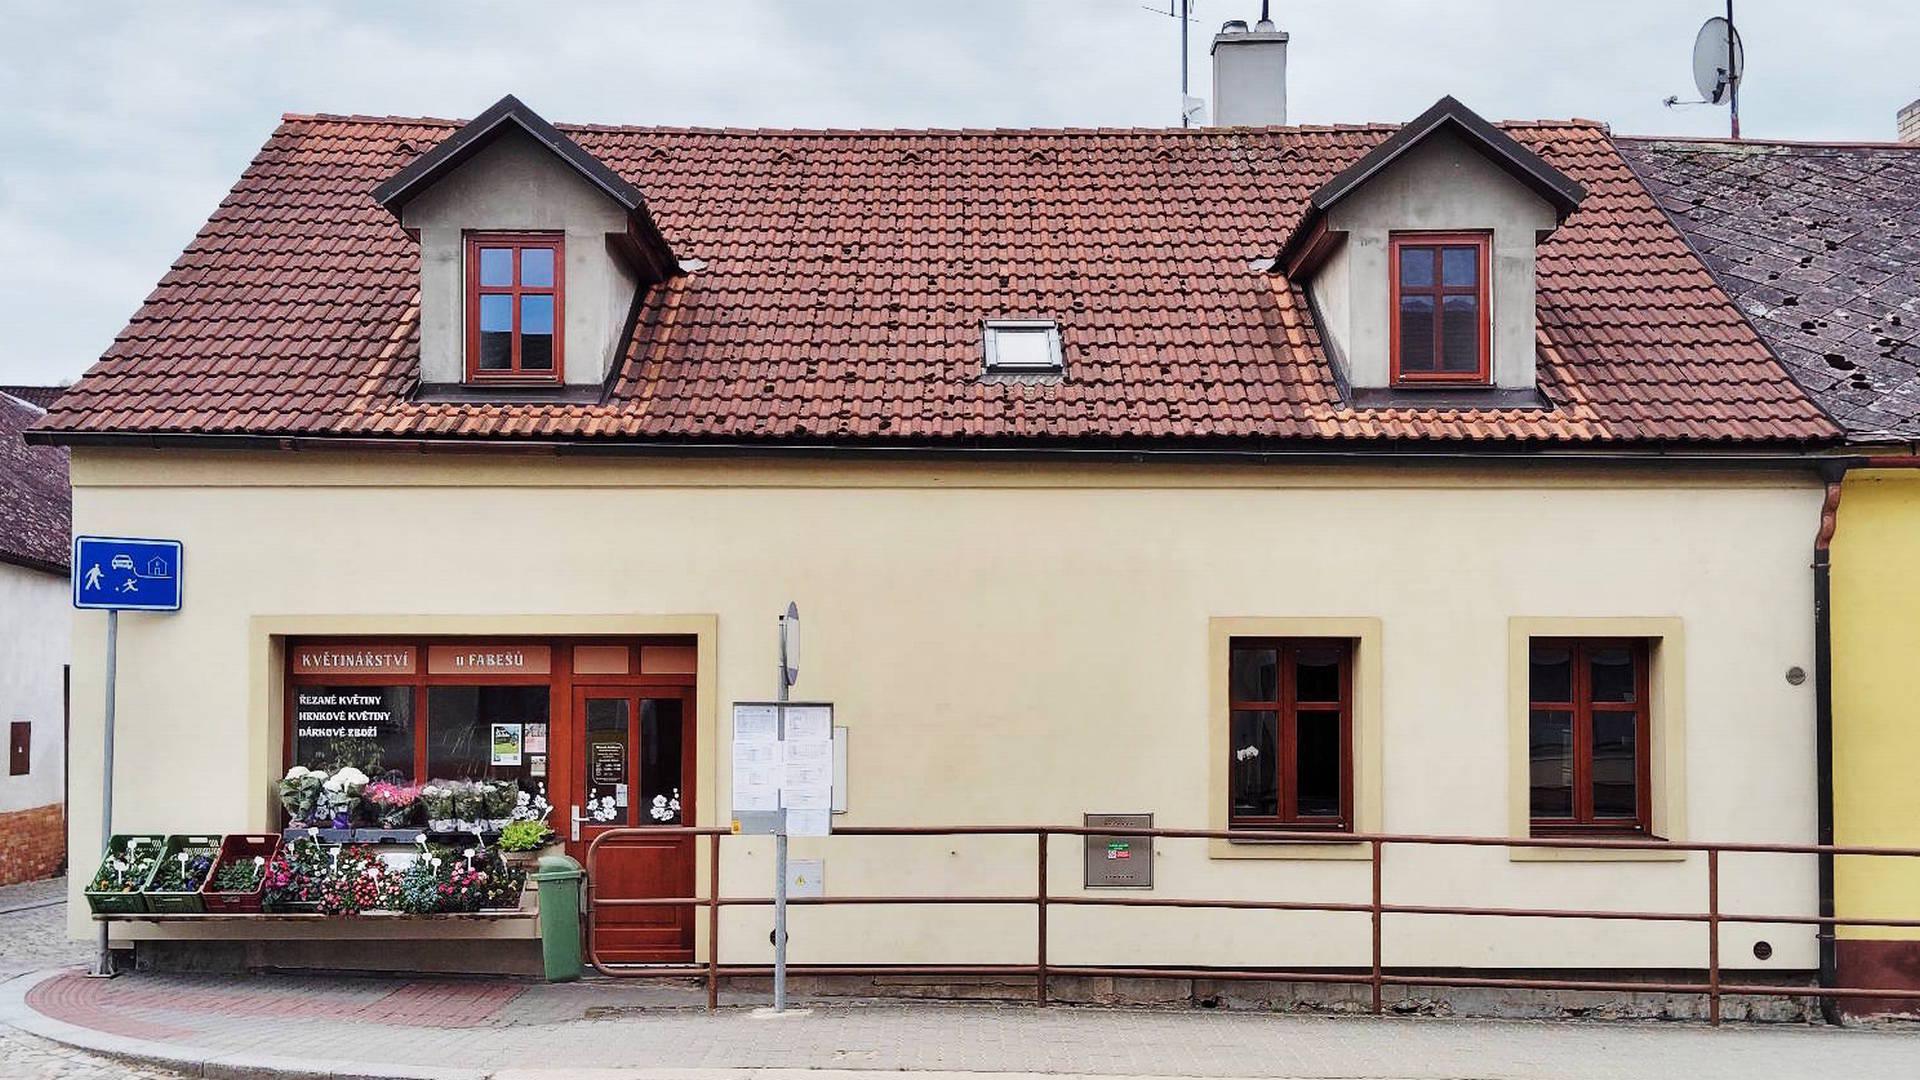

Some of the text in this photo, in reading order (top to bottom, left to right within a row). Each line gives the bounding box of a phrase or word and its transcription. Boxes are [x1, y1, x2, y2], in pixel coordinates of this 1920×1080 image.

[302, 651, 409, 667] KVĚTINÁŘSTVÍ
[469, 651, 524, 667] FABEŠŮ
[299, 694, 382, 705] ŘEZANÉ KVĚTINY
[299, 711, 391, 721] HRNKOVÉ KVĚTINY
[299, 726, 377, 737] DÁRKOVÉ ZBOŽÍ
